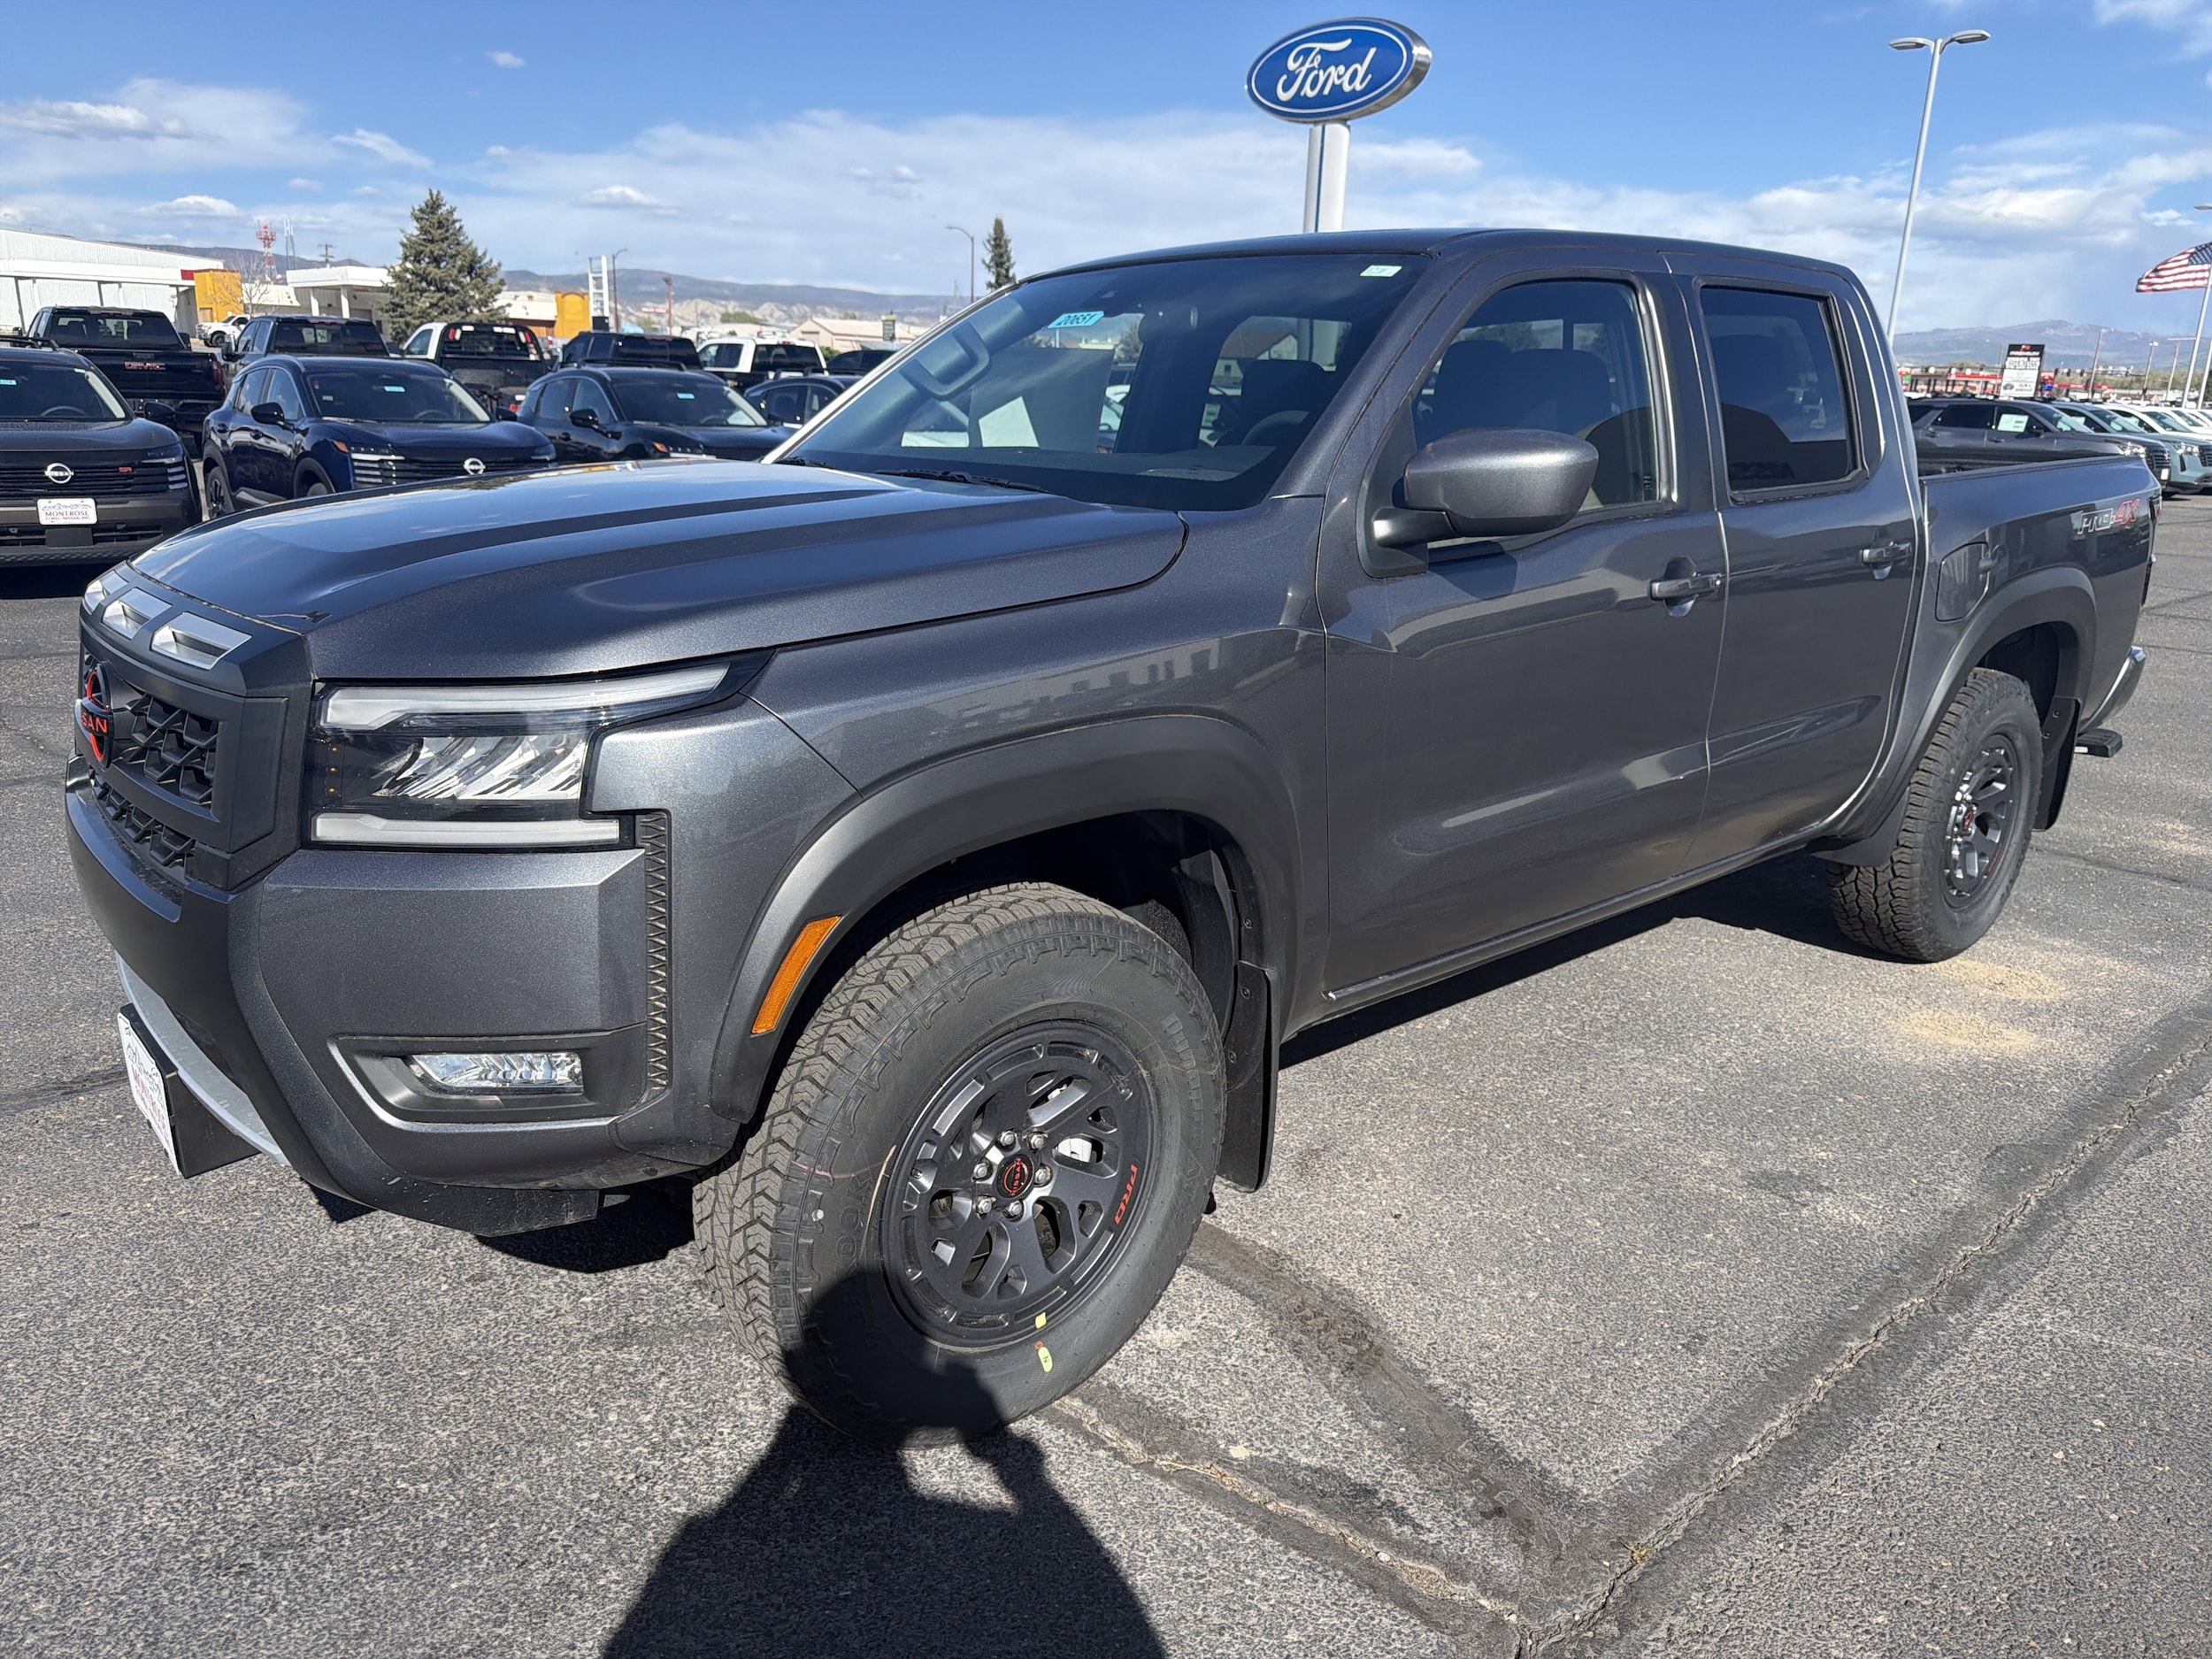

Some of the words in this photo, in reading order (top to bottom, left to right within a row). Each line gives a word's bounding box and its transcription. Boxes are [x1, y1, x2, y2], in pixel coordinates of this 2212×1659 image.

[1277, 38, 1377, 102] Ford
[1010, 1157, 1023, 1197] NISSAN
[1114, 1164, 1139, 1225] PRO
